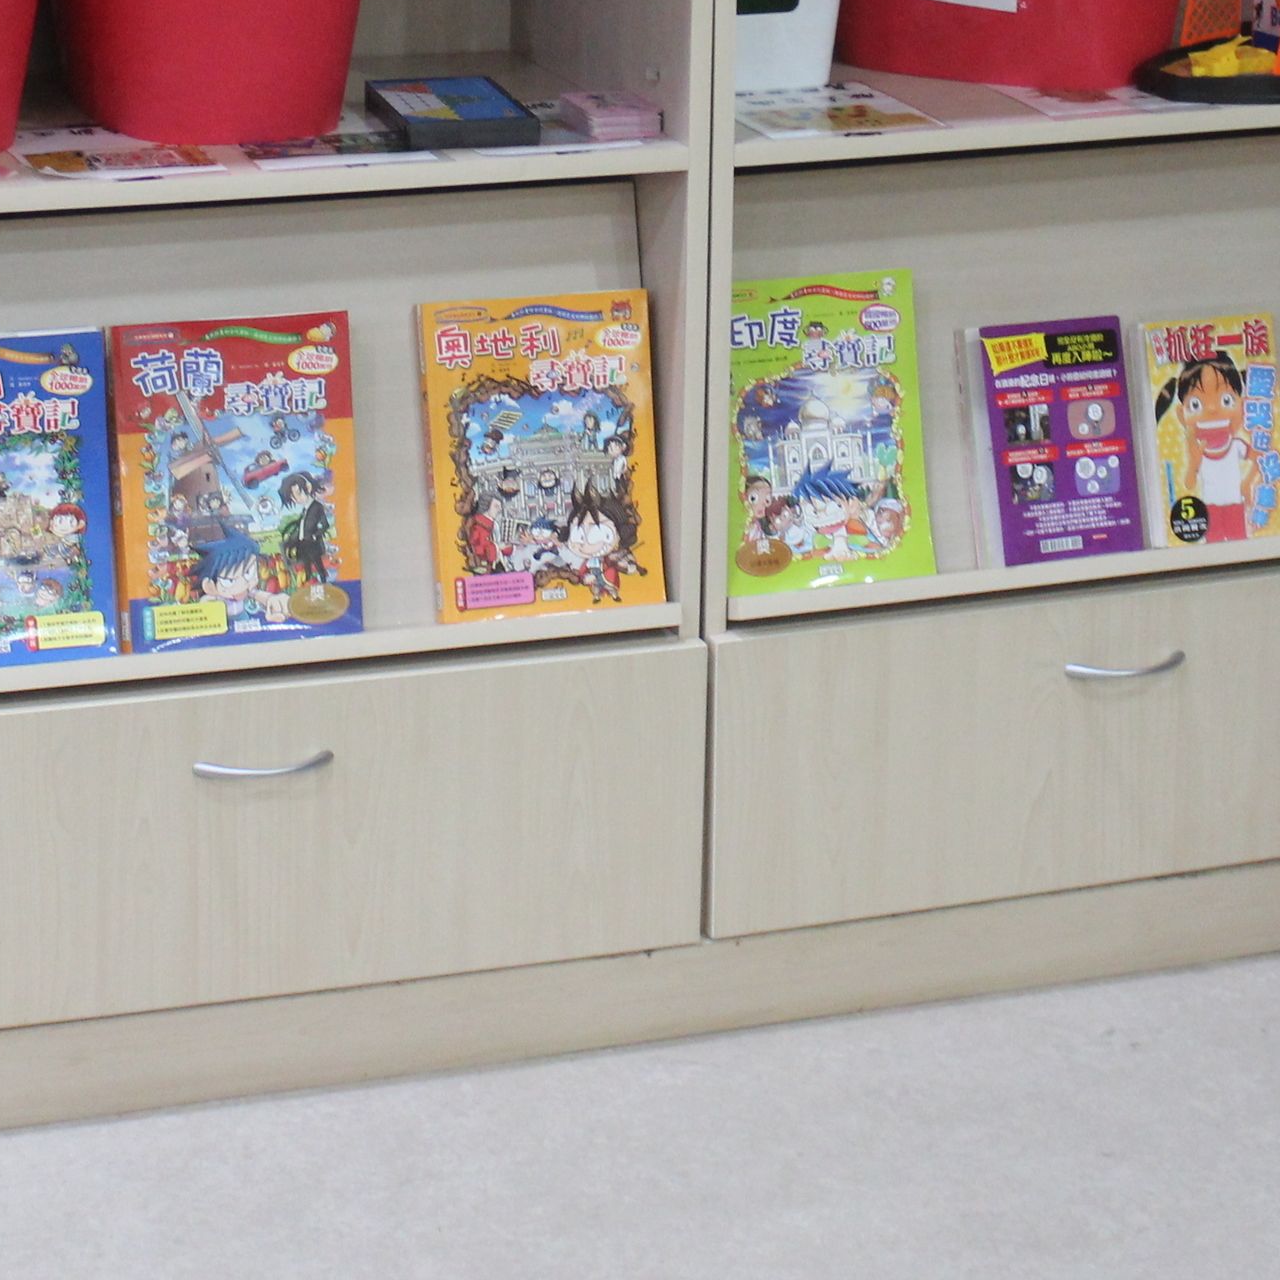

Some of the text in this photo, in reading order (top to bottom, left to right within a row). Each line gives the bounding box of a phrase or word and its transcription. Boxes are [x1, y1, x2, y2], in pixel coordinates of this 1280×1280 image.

[434, 323, 561, 370] 奧地利
[730, 306, 802, 349] 印度
[802, 332, 897, 371] 尋寶記
[131, 348, 223, 397] 荷蘭
[529, 352, 626, 392] 尋寶記
[224, 376, 327, 416] 尋寶記
[1180, 498, 1196, 521] 5
